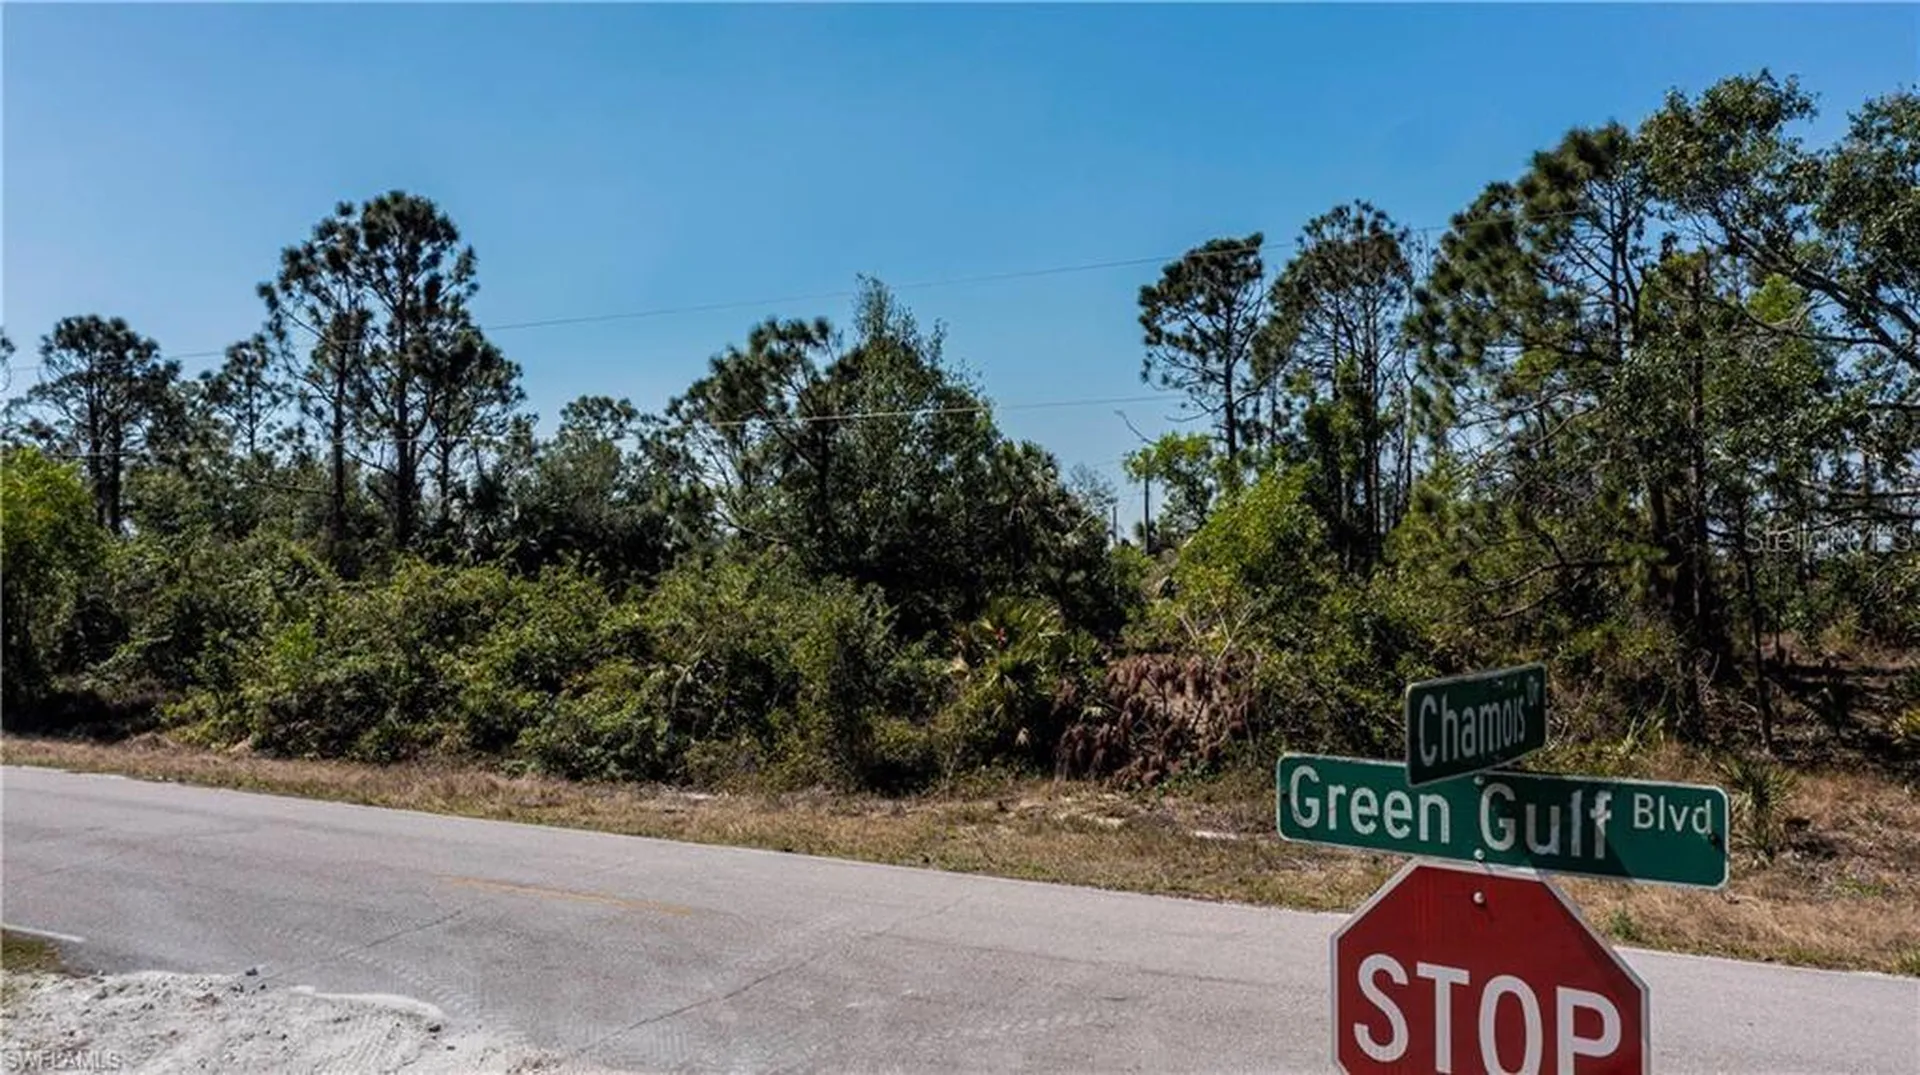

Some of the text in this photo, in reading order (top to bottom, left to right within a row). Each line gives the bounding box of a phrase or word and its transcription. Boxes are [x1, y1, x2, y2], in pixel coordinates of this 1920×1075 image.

[1419, 681, 1526, 767] Chamois
[1289, 765, 1713, 860] Green Gulf Blvd
[1353, 953, 1622, 1075] STOP
